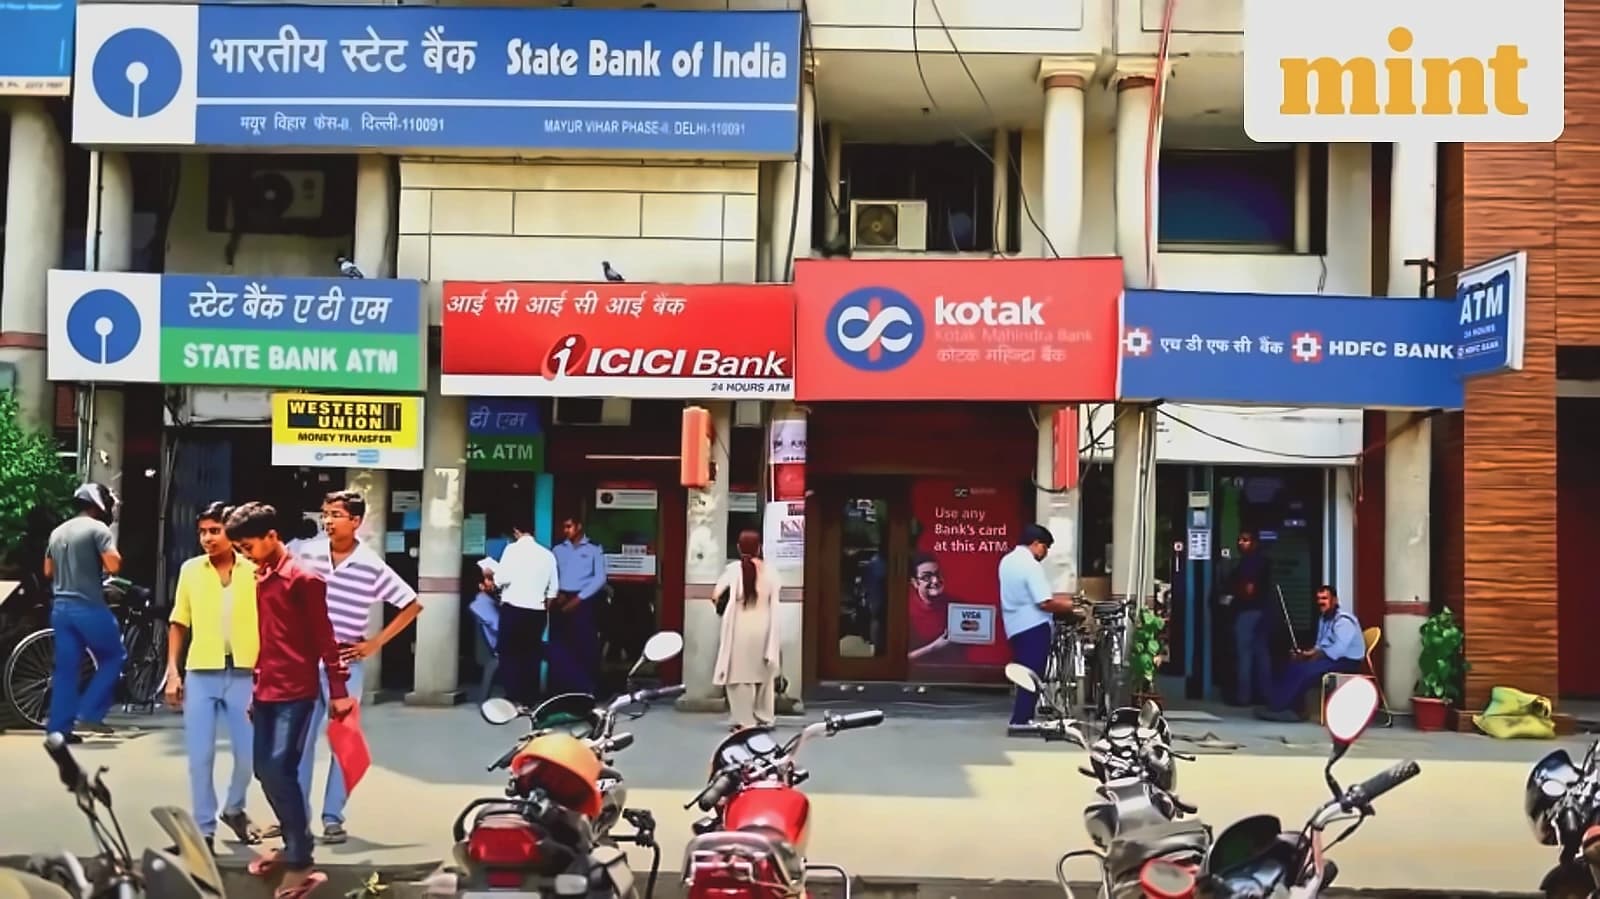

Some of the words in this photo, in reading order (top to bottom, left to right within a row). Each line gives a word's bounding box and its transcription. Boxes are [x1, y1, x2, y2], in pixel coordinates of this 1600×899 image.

[210, 24, 327, 74] भारतीय
[339, 25, 408, 73] स्टेट
[421, 25, 478, 74] बैंक
[506, 38, 579, 76] State
[588, 39, 661, 76] Bank
[671, 41, 703, 77] of
[713, 41, 787, 78] India
[240, 114, 266, 135] मयूर
[274, 112, 306, 131] विहार
[544, 119, 583, 133] MAYUR
[585, 120, 619, 134] VIHAR
[189, 281, 238, 317] स्टेट
[243, 282, 287, 319] बैंक
[293, 295, 315, 323] ए
[317, 286, 345, 321] टी
[350, 297, 392, 325] एम
[447, 290, 486, 316] आई
[495, 290, 518, 313] सी
[525, 290, 567, 317] आई
[574, 290, 598, 314] सी
[606, 290, 647, 318] आई
[653, 291, 687, 316] बैंक
[935, 296, 1046, 326] kotak
[1459, 284, 1504, 326] ATM
[935, 328, 976, 342] Kotak
[981, 327, 1053, 343] Mahindra
[1057, 327, 1092, 342] Bank
[1160, 337, 1182, 352] एच
[1185, 334, 1203, 351] डी
[1206, 339, 1229, 354] एफ
[1232, 335, 1253, 353] सी
[1258, 336, 1284, 354] बैंक
[183, 343, 260, 369] STATE
[268, 346, 338, 371] BANK
[346, 348, 398, 374] ATM
[937, 345, 980, 362] कोटक
[1328, 340, 1387, 356] HDFC
[1393, 342, 1455, 359] BANK
[586, 348, 687, 376] ICICI
[692, 350, 787, 377] Bank
[711, 382, 724, 393] 24
[726, 382, 764, 393] HOURS
[767, 382, 790, 393] ATM
[289, 401, 382, 416] WESTERN
[470, 405, 490, 429] टी
[318, 416, 382, 430] UNION
[297, 431, 335, 442] MONEY
[339, 432, 392, 443] TRANSFER
[492, 443, 533, 459] ATM
[935, 506, 958, 518] Use
[961, 509, 986, 522] any
[934, 523, 975, 535] Bank's
[978, 523, 1007, 536] card
[933, 541, 948, 552] at
[950, 540, 976, 552] this
[977, 541, 1009, 552] ATM
